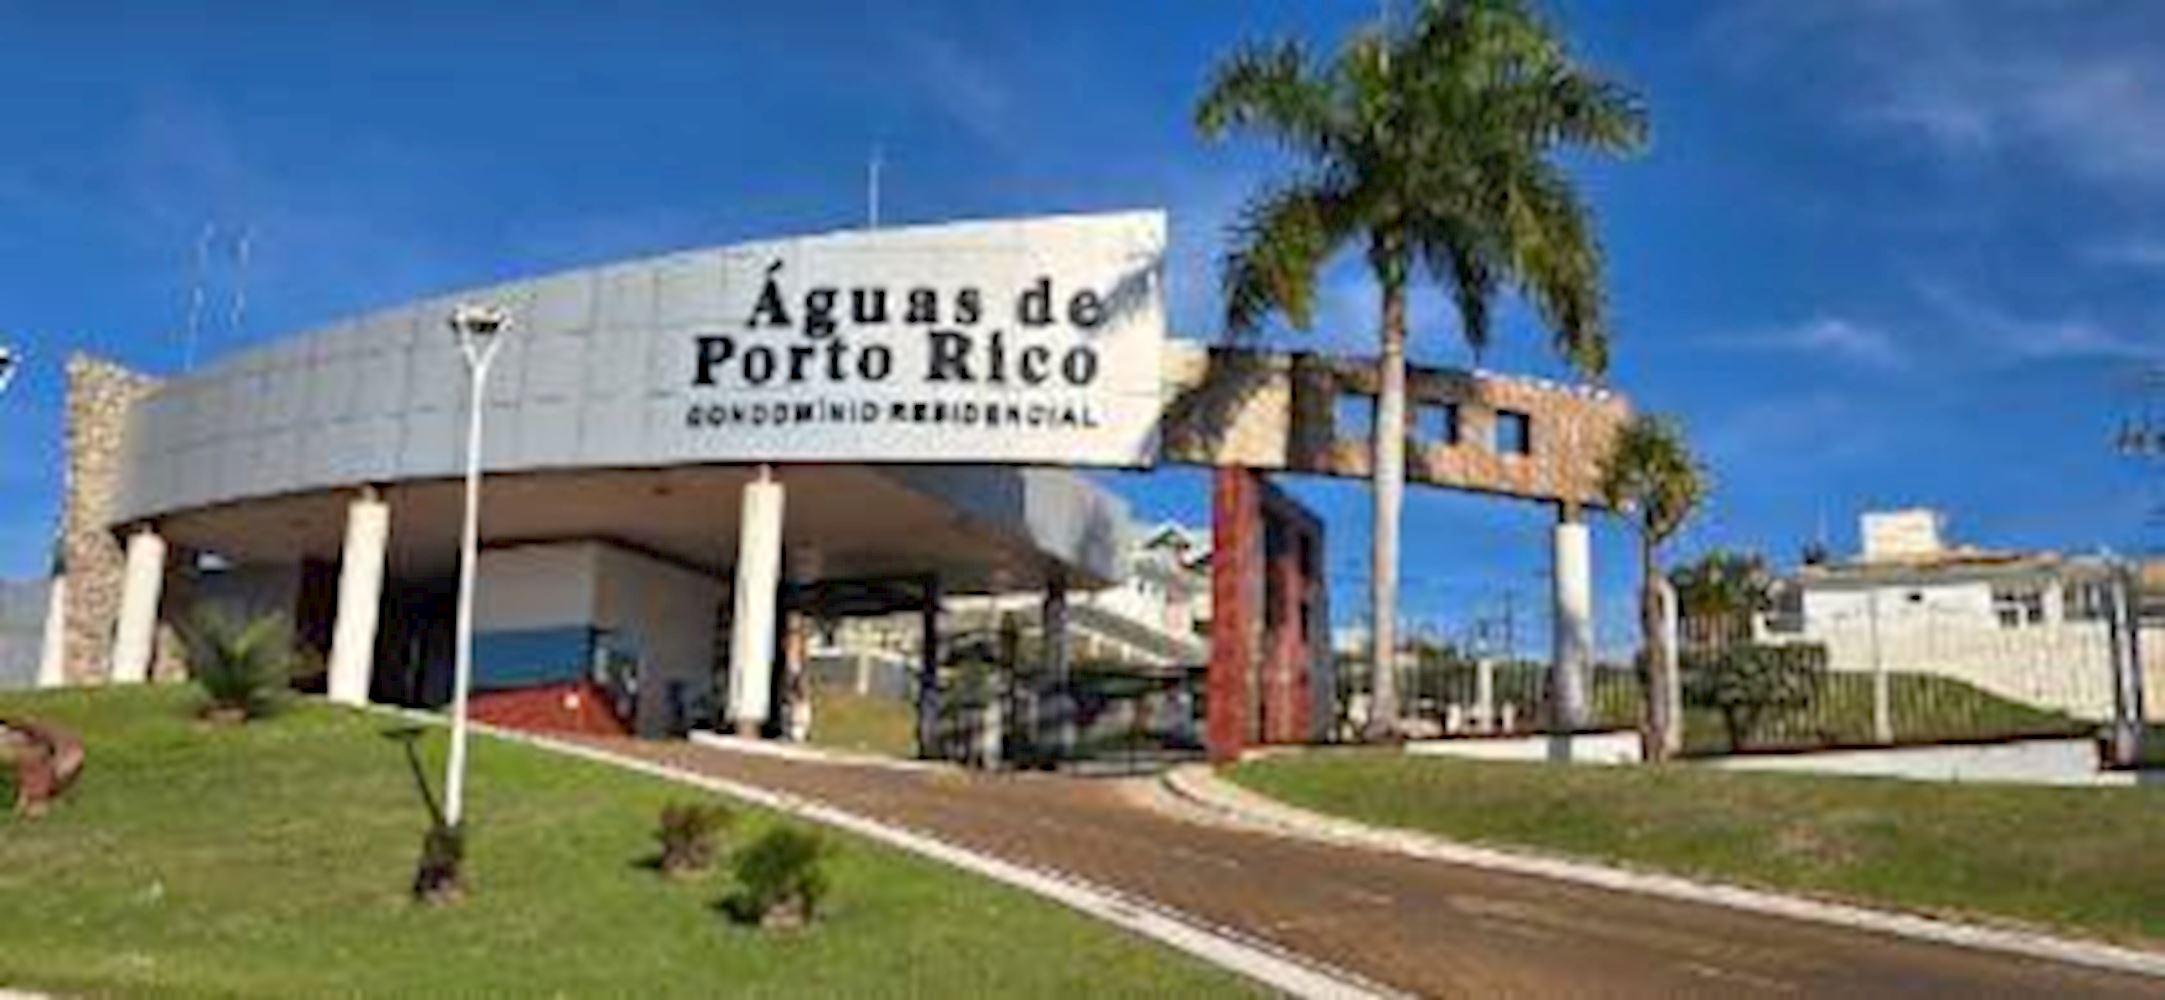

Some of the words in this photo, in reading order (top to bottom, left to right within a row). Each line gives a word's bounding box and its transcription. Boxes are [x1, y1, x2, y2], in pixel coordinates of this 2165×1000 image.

[745, 258, 982, 339] Águas
[1015, 276, 1101, 328] de
[690, 334, 893, 387] Porto
[922, 330, 1099, 386] Rico
[887, 401, 1099, 429] RESIDENCIAL
